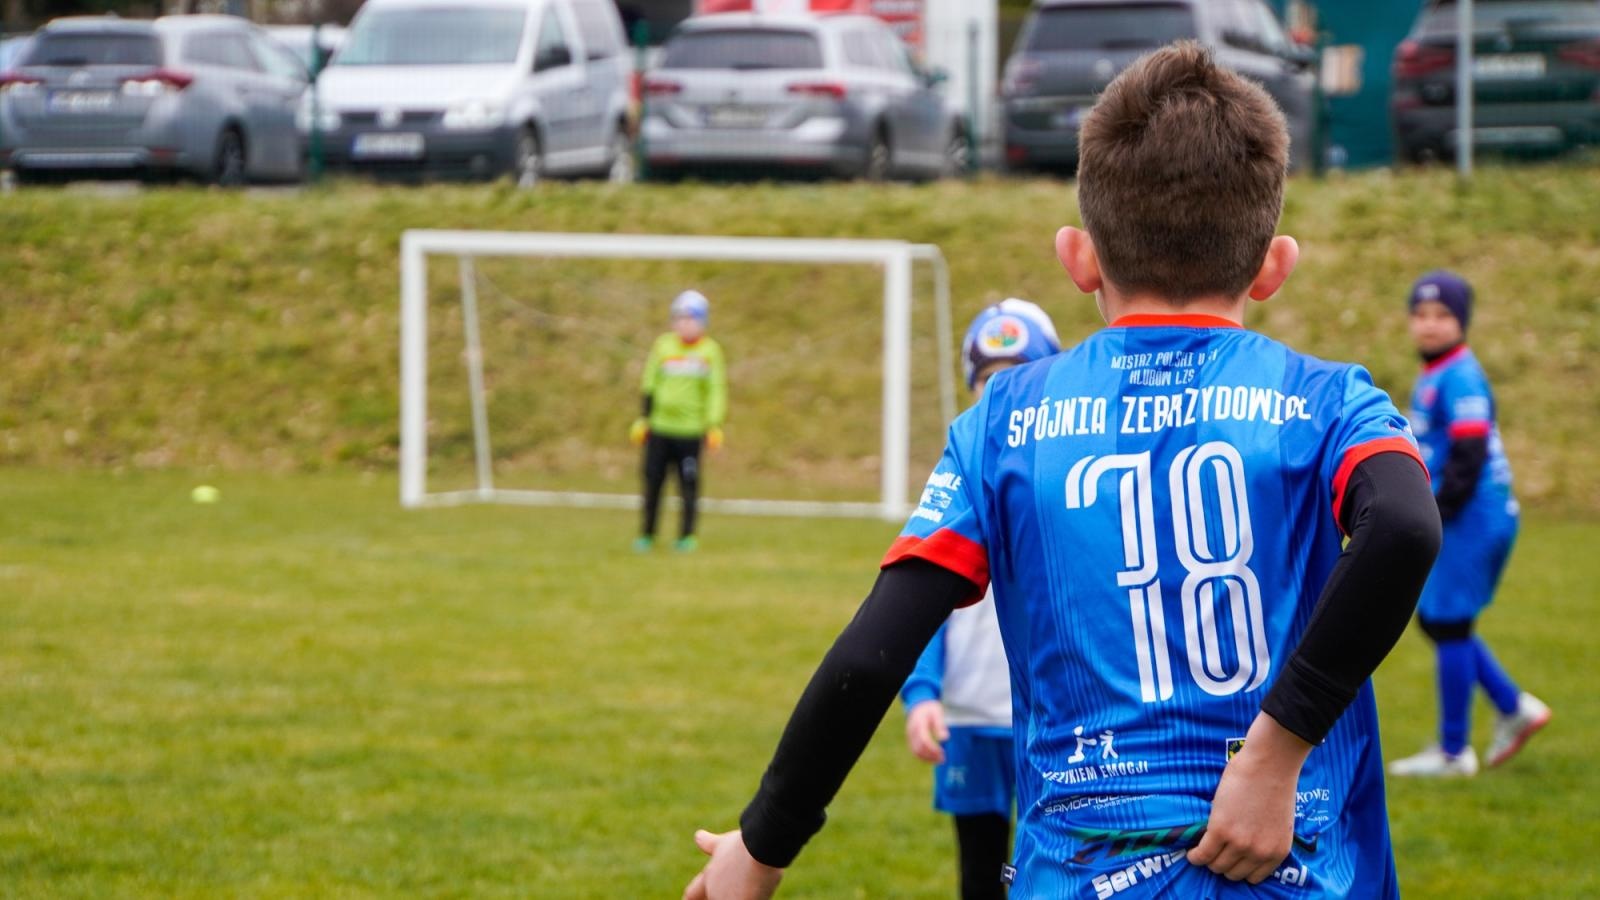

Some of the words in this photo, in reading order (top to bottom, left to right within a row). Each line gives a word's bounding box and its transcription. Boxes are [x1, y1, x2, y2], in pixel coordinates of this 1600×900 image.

[1175, 368, 1195, 385] LZS
[1007, 397, 1106, 447] SPÓJNIA
[1065, 440, 1270, 703] 18
[1100, 760, 1149, 778] EMOCJI
